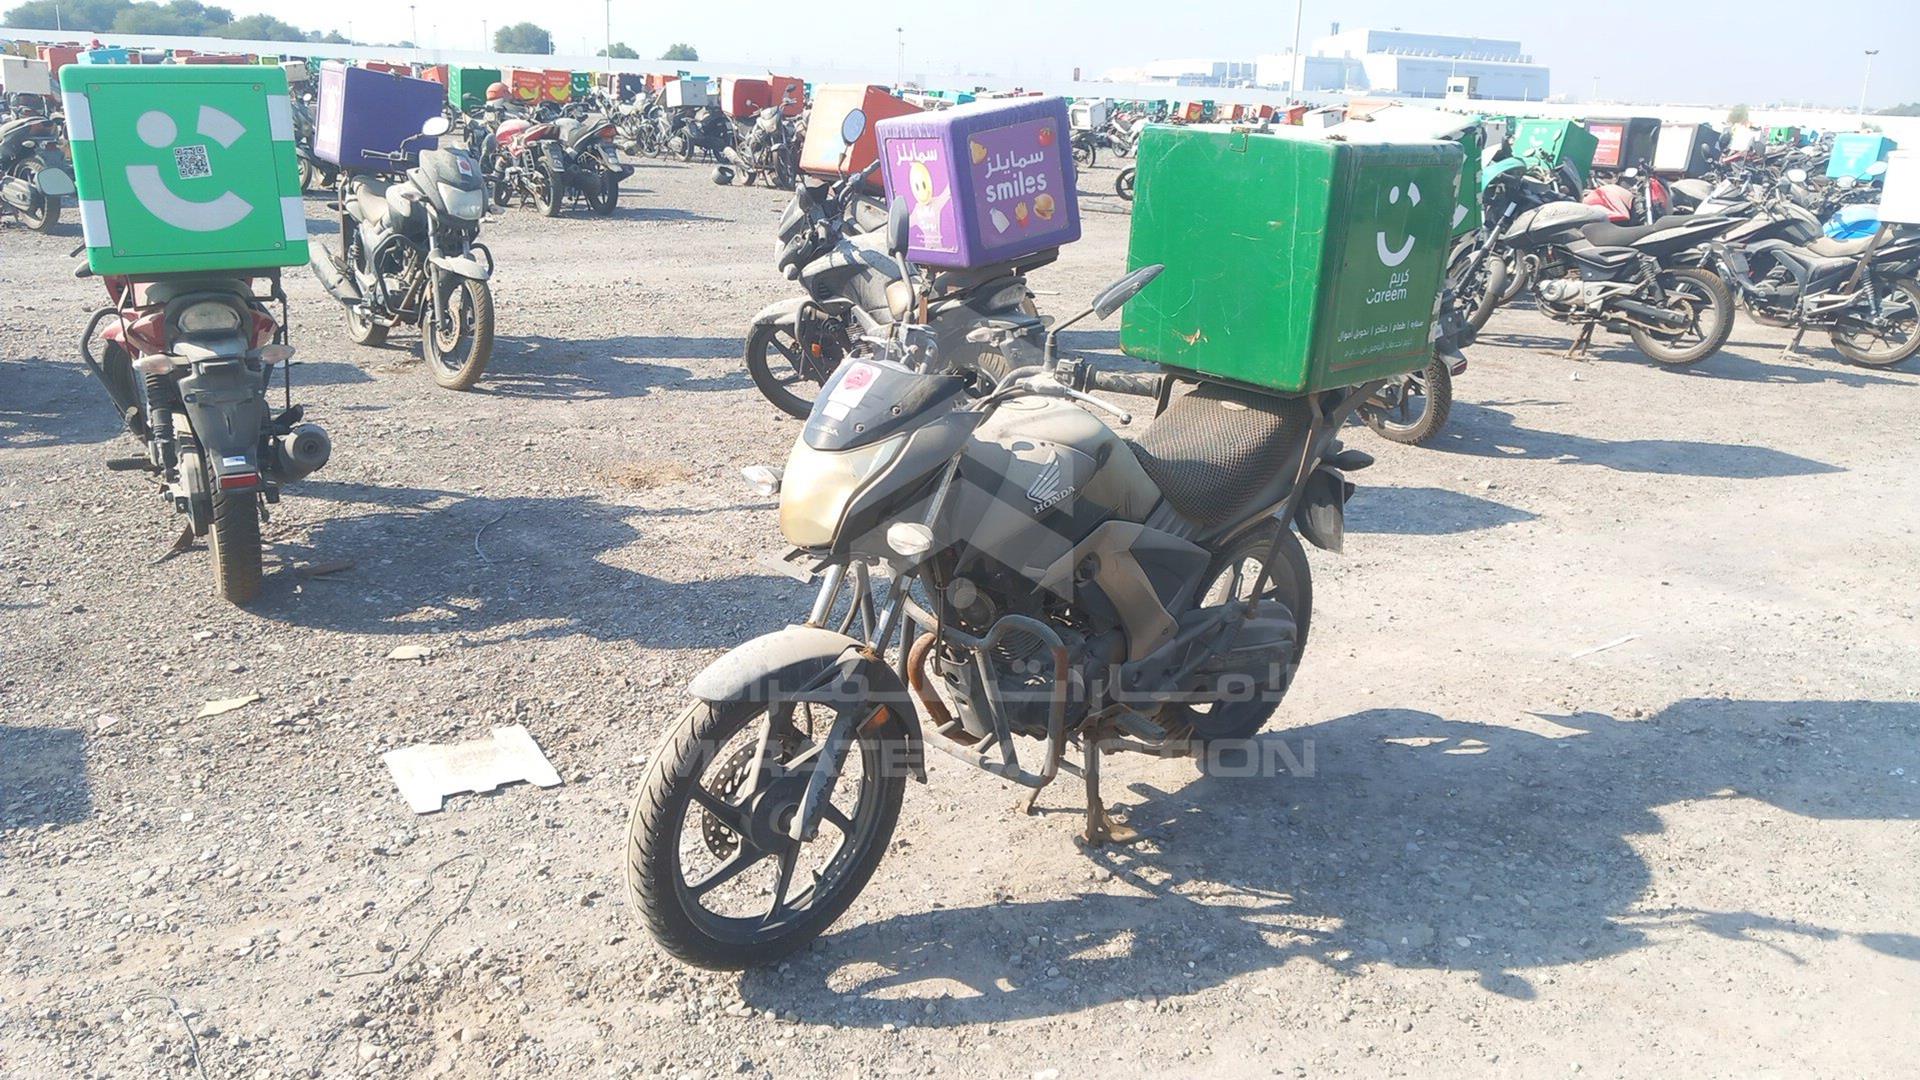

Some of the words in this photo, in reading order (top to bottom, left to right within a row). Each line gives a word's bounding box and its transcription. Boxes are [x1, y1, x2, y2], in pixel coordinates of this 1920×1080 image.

[895, 142, 938, 166] سمايلز
[985, 150, 1045, 179] سمايلز
[985, 171, 1048, 203] smiles
[1389, 268, 1410, 288] كريم
[1366, 288, 1407, 304] Careem
[1033, 486, 1076, 514] HONDA
